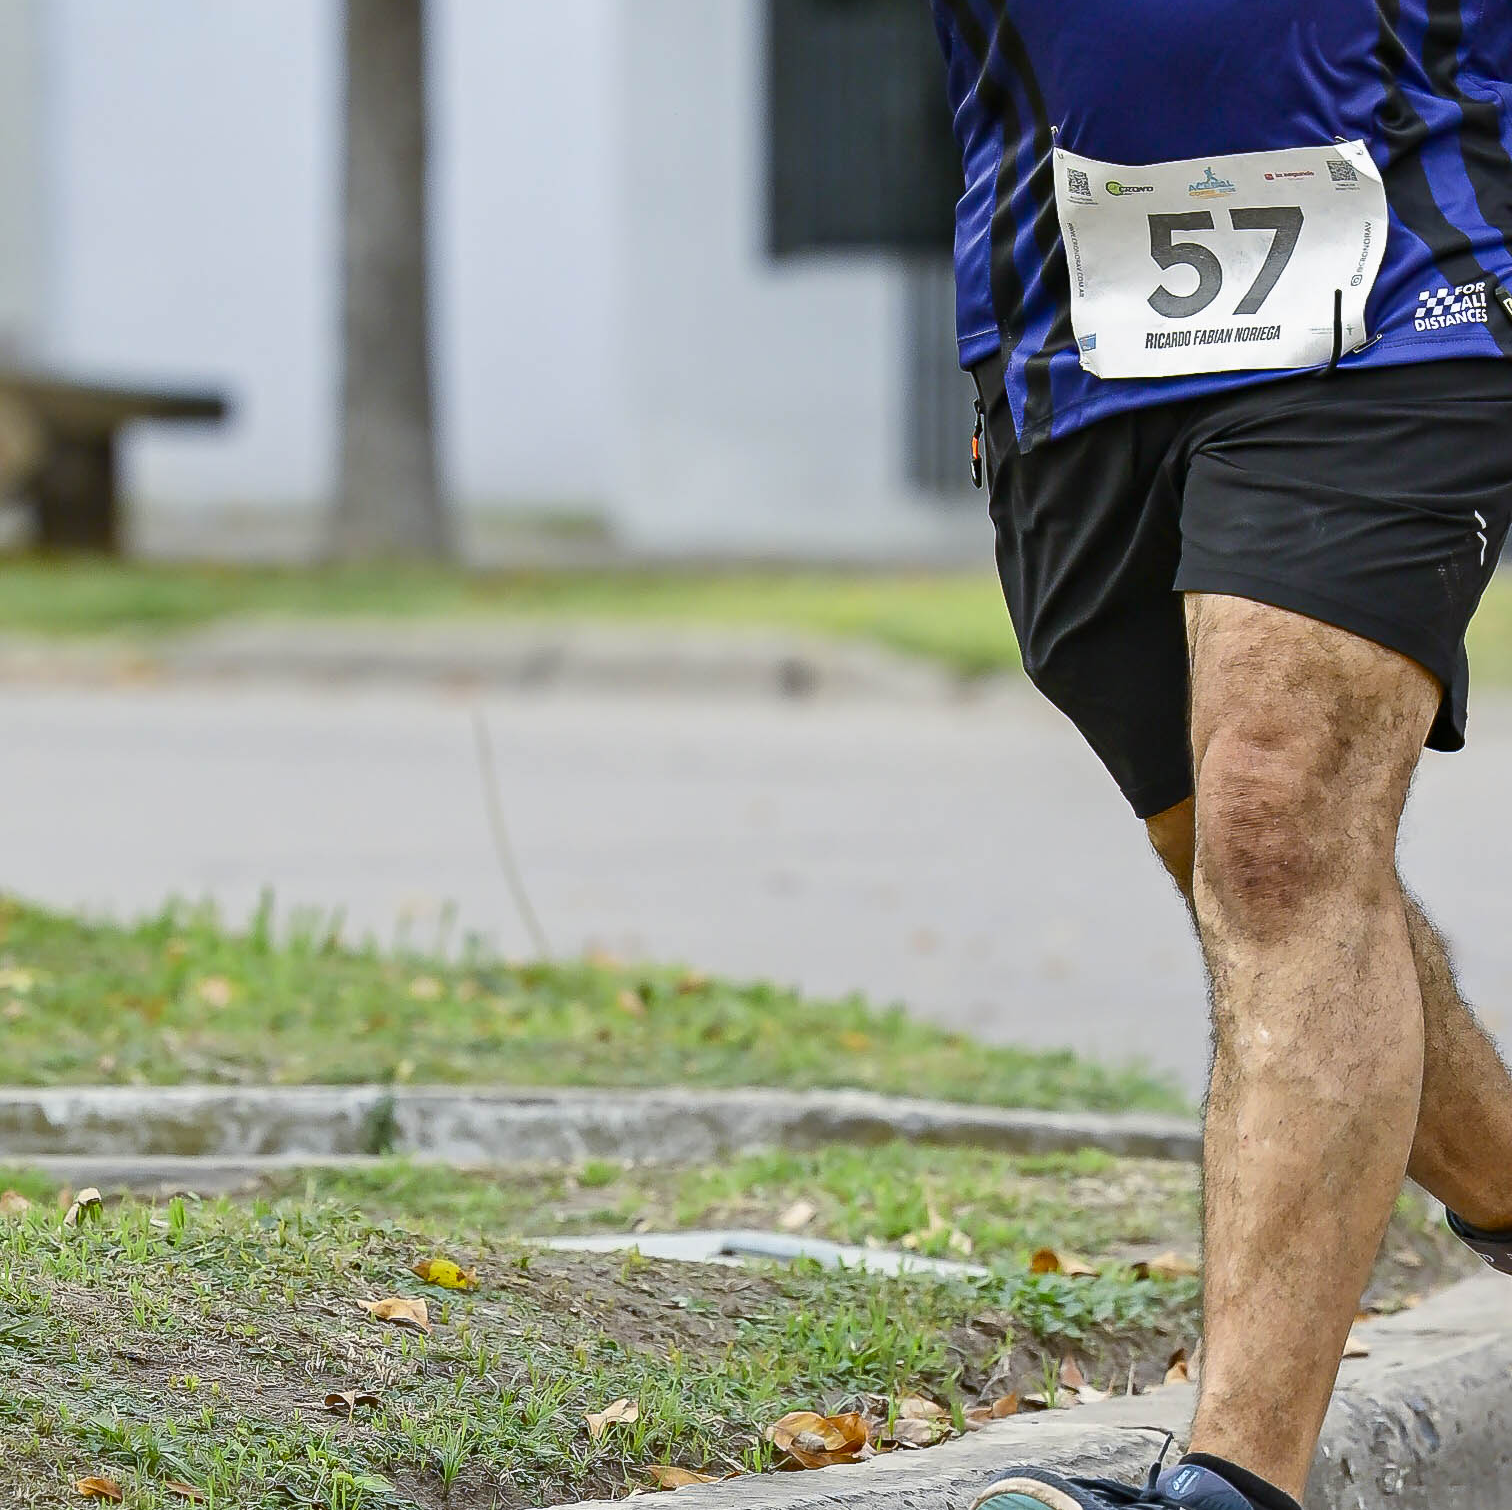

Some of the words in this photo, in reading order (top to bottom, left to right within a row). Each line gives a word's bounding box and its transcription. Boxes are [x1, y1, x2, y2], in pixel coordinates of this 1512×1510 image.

[1147, 206, 1304, 319] 57
[1455, 282, 1486, 295] FOR
[1461, 292, 1487, 310] ALL
[1414, 308, 1488, 331] DISTANCES
[1145, 330, 1192, 349] RICARDO
[1193, 328, 1234, 345] FABIAN
[1234, 324, 1281, 342] NORIEGA
